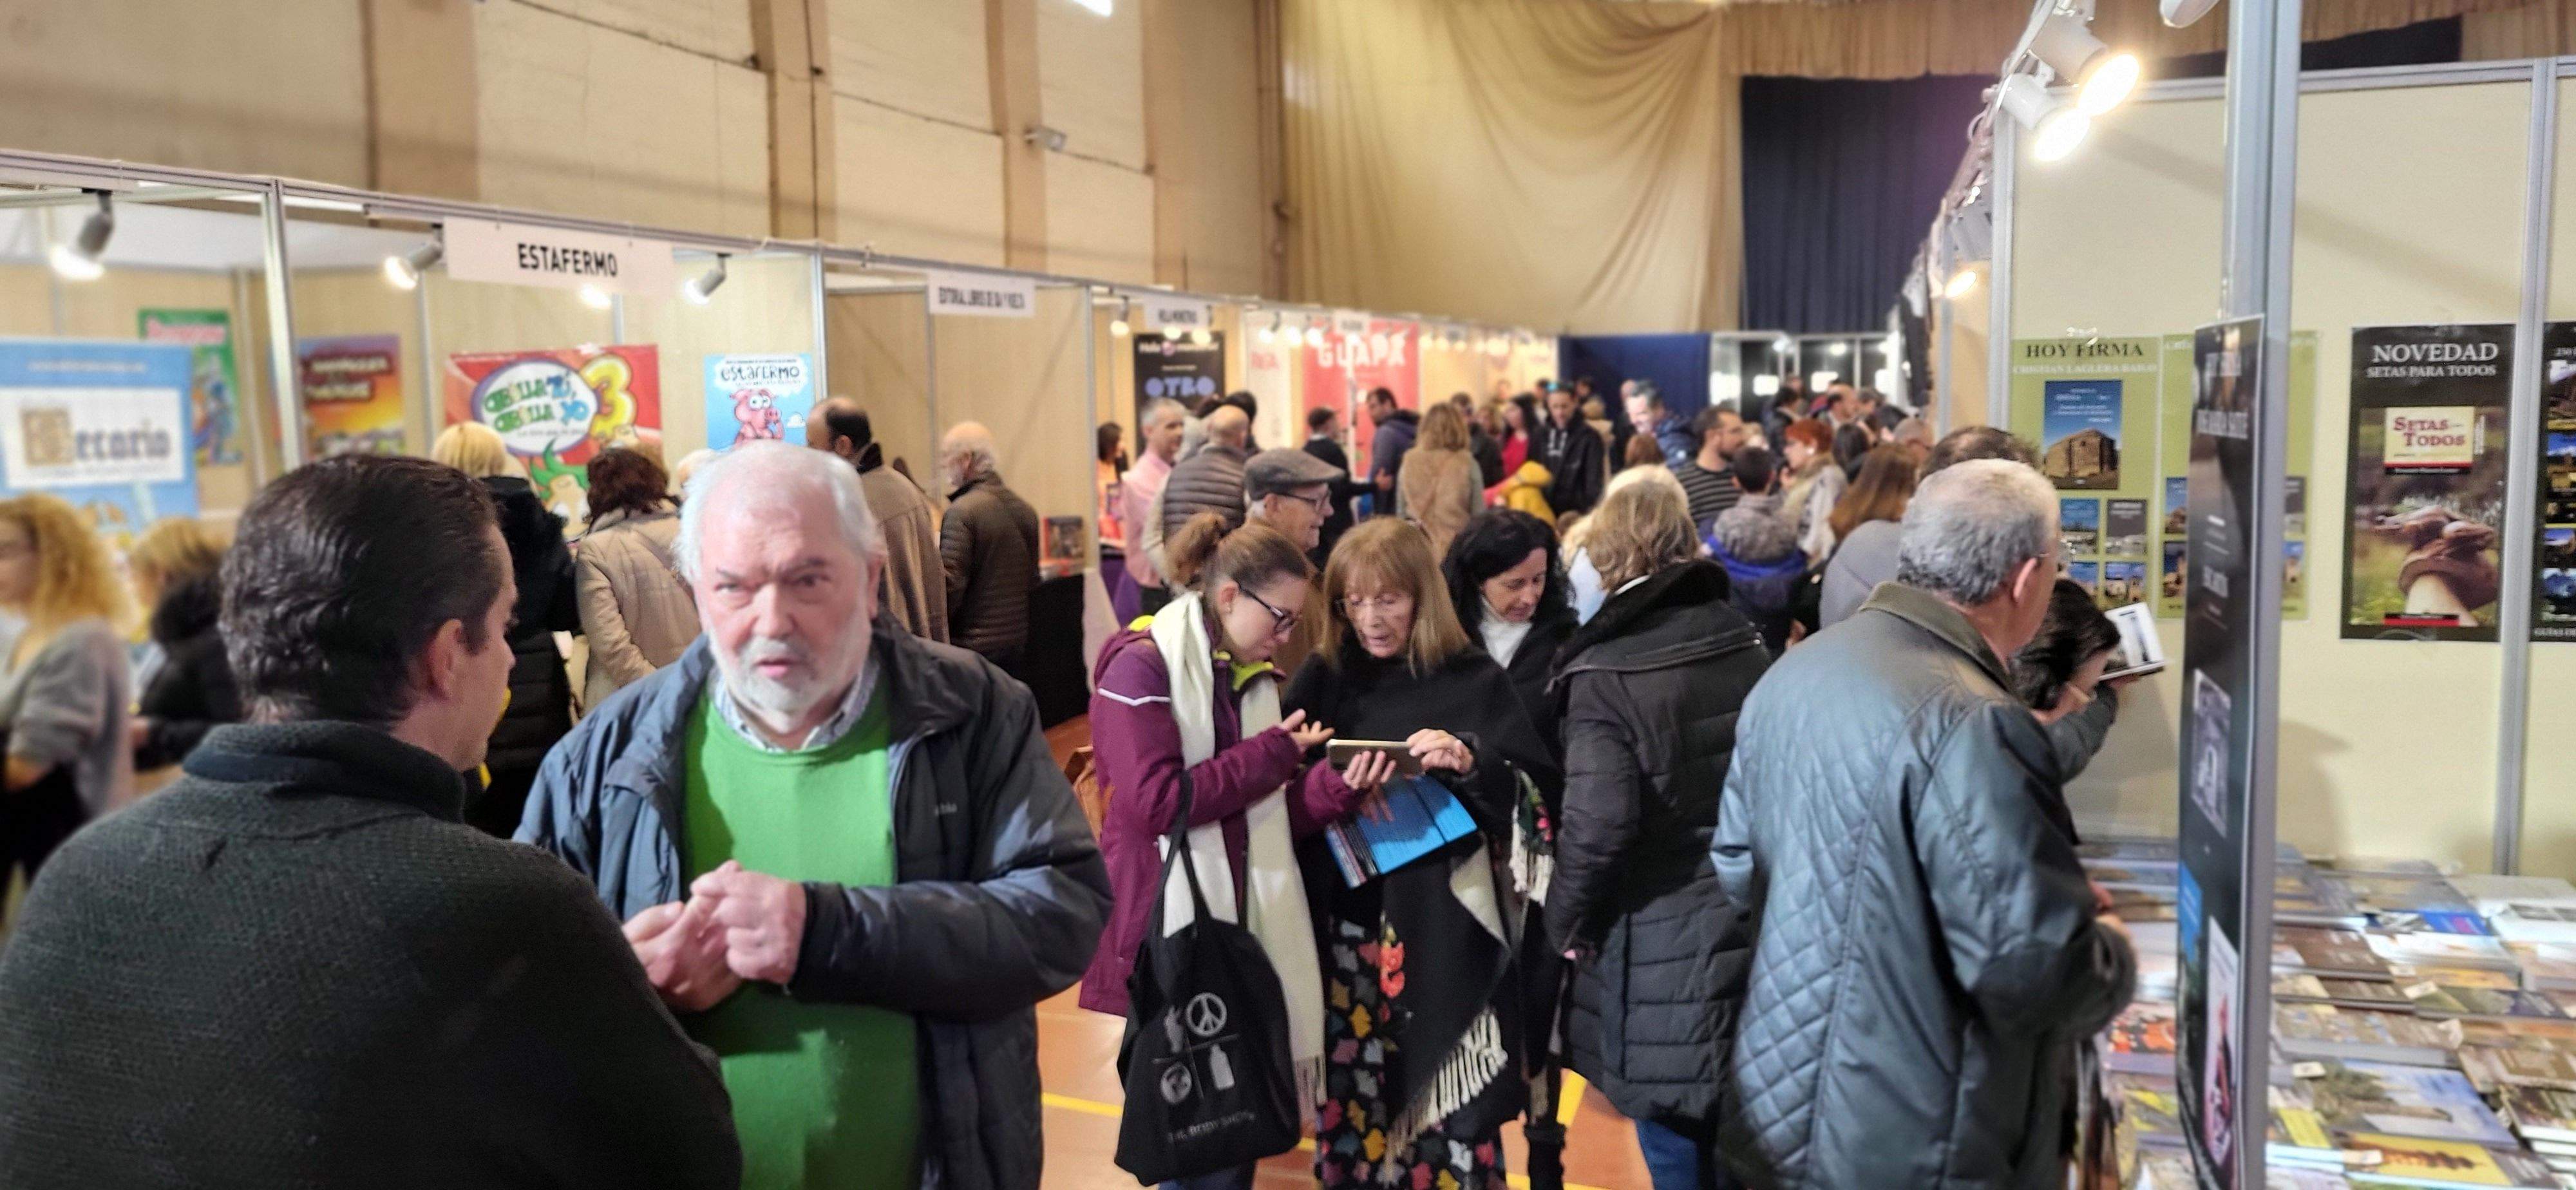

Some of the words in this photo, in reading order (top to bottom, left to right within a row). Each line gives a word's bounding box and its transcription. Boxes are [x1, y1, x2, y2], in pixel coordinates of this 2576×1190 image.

[518, 243, 618, 277] ESTAFERMO
[2027, 344, 2067, 358] HOY
[2076, 342, 2144, 357] FIRMA
[2372, 342, 2499, 363] NOVEDAD
[2366, 365, 2407, 378] SETAS
[2409, 365, 2445, 377] PARA
[2447, 364, 2497, 377] TODOS
[581, 354, 637, 441] 3
[2403, 432, 2465, 446] TODOS
